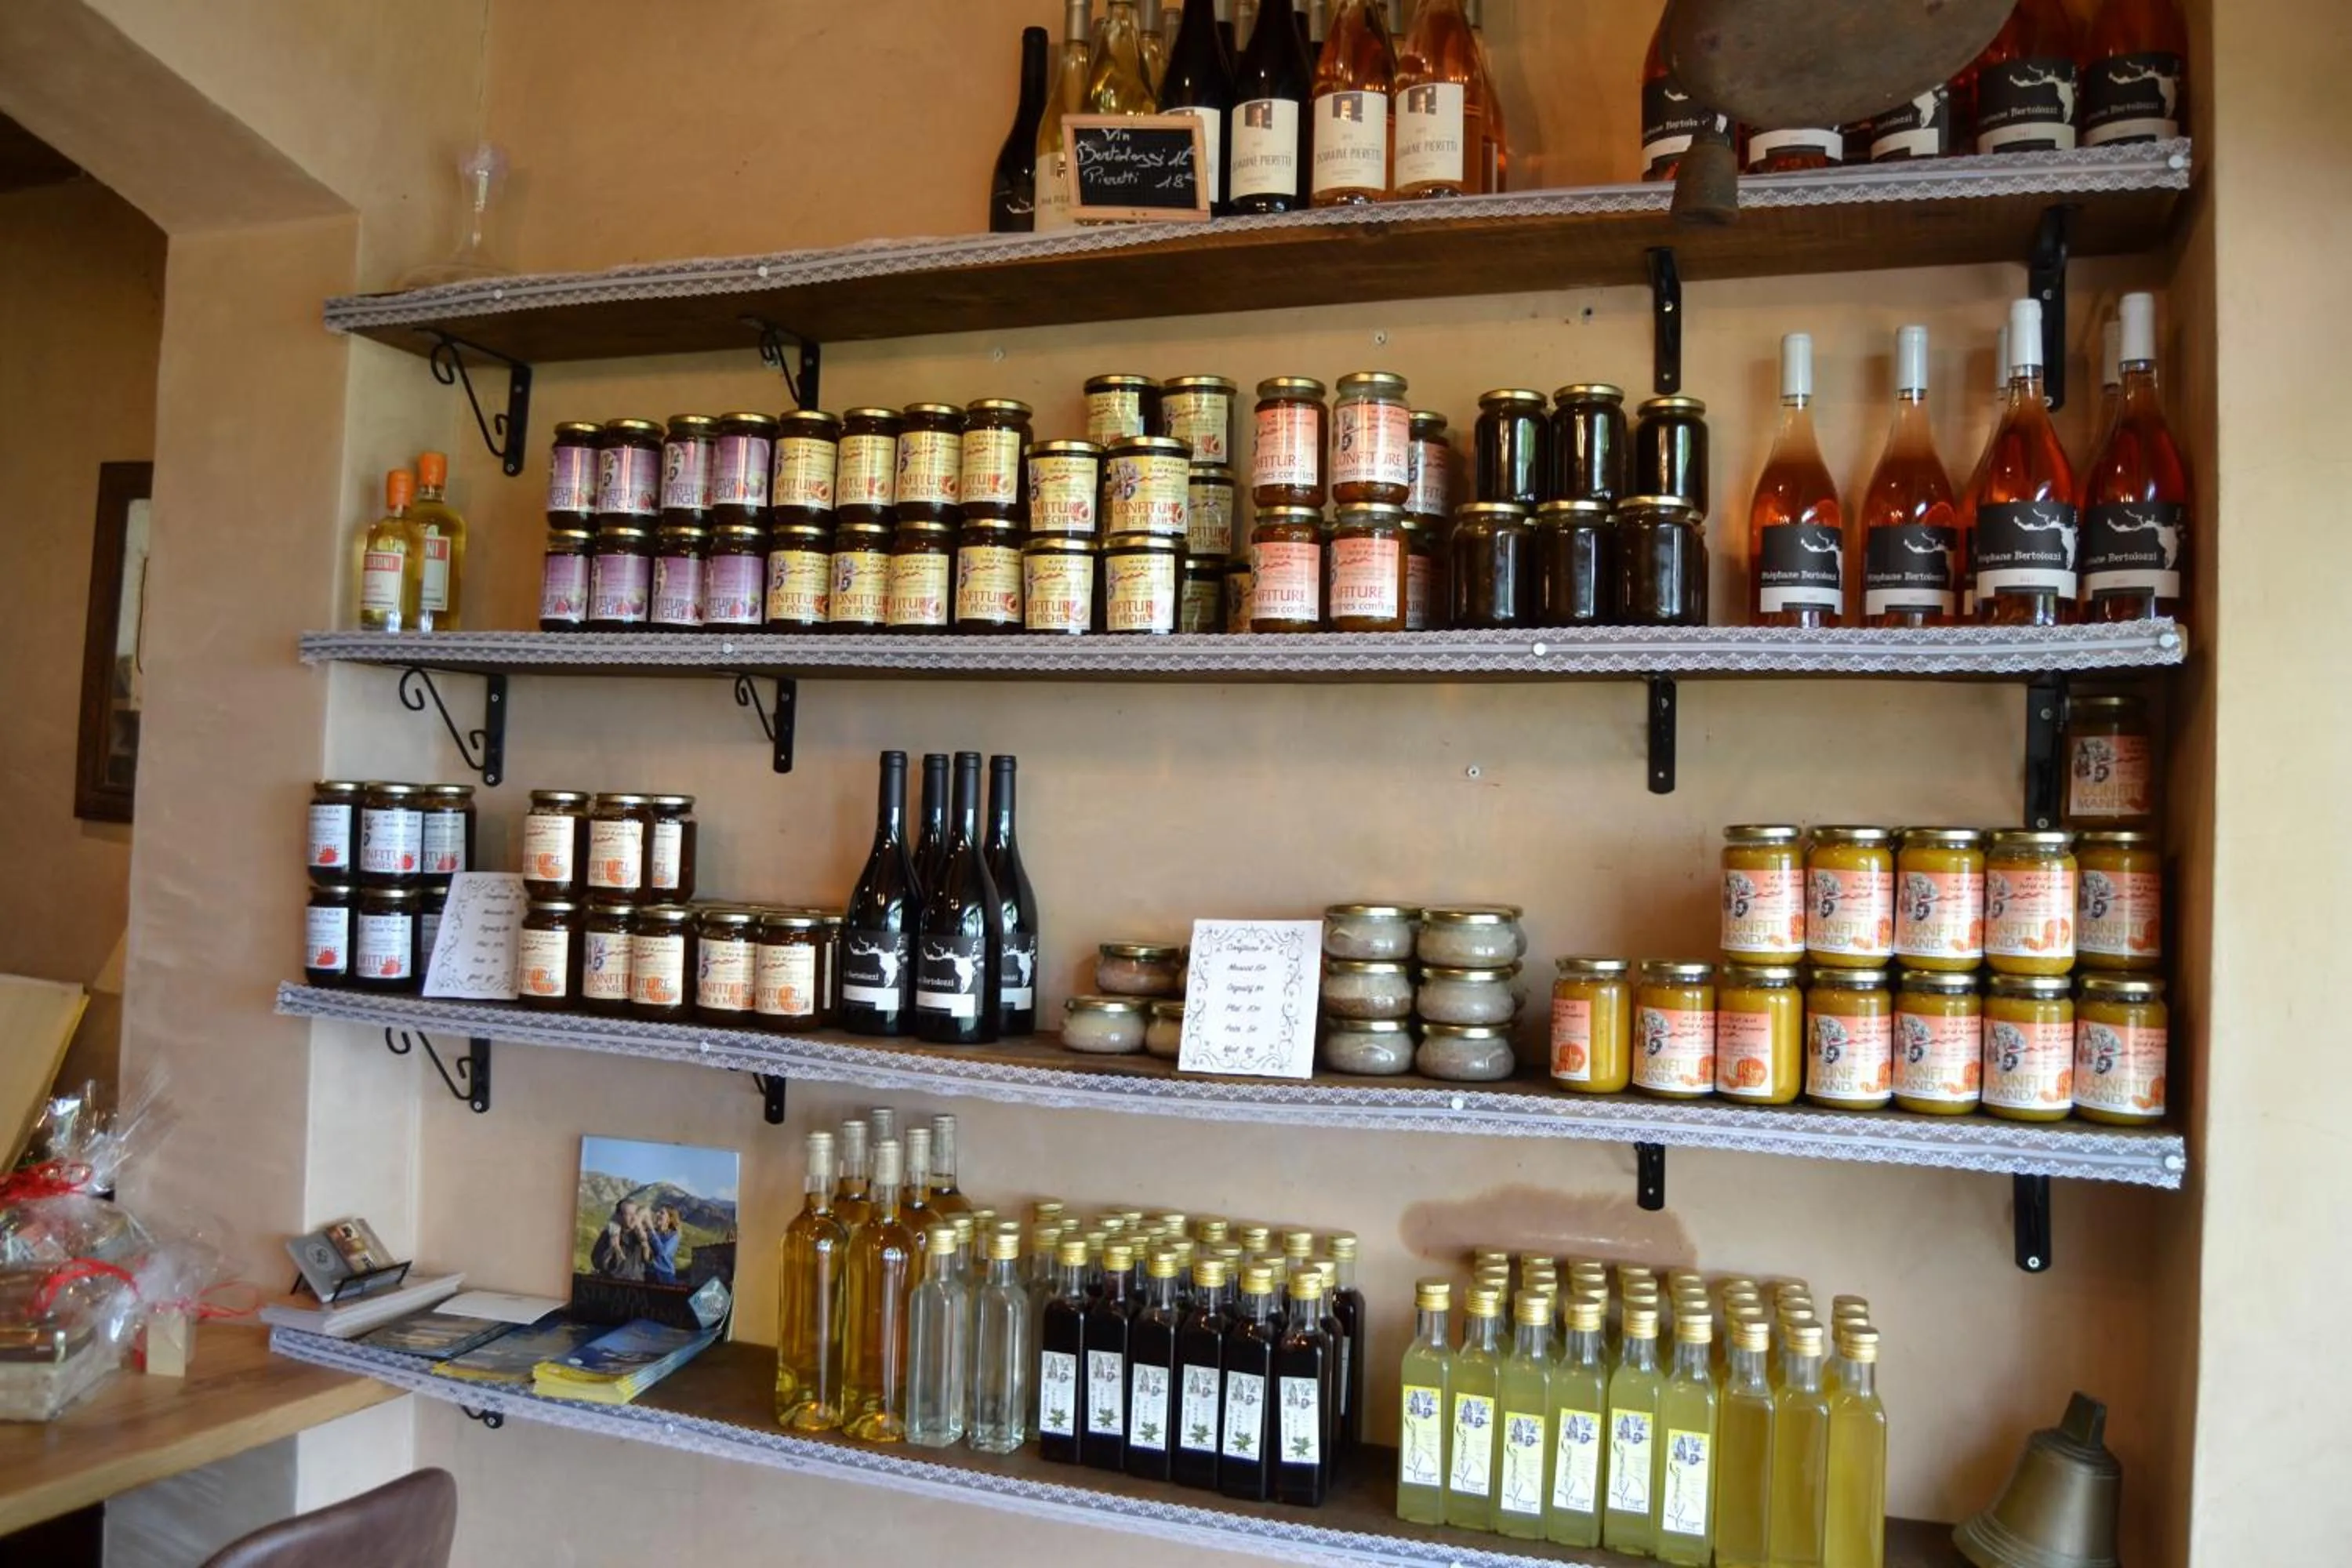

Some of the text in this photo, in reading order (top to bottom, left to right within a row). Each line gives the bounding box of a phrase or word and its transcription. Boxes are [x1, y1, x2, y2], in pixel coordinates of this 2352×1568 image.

[1102, 128, 1131, 142] Vin
[2014, 550, 2062, 561] Bertolozzi
[2107, 551, 2158, 563] Bertolozzi
